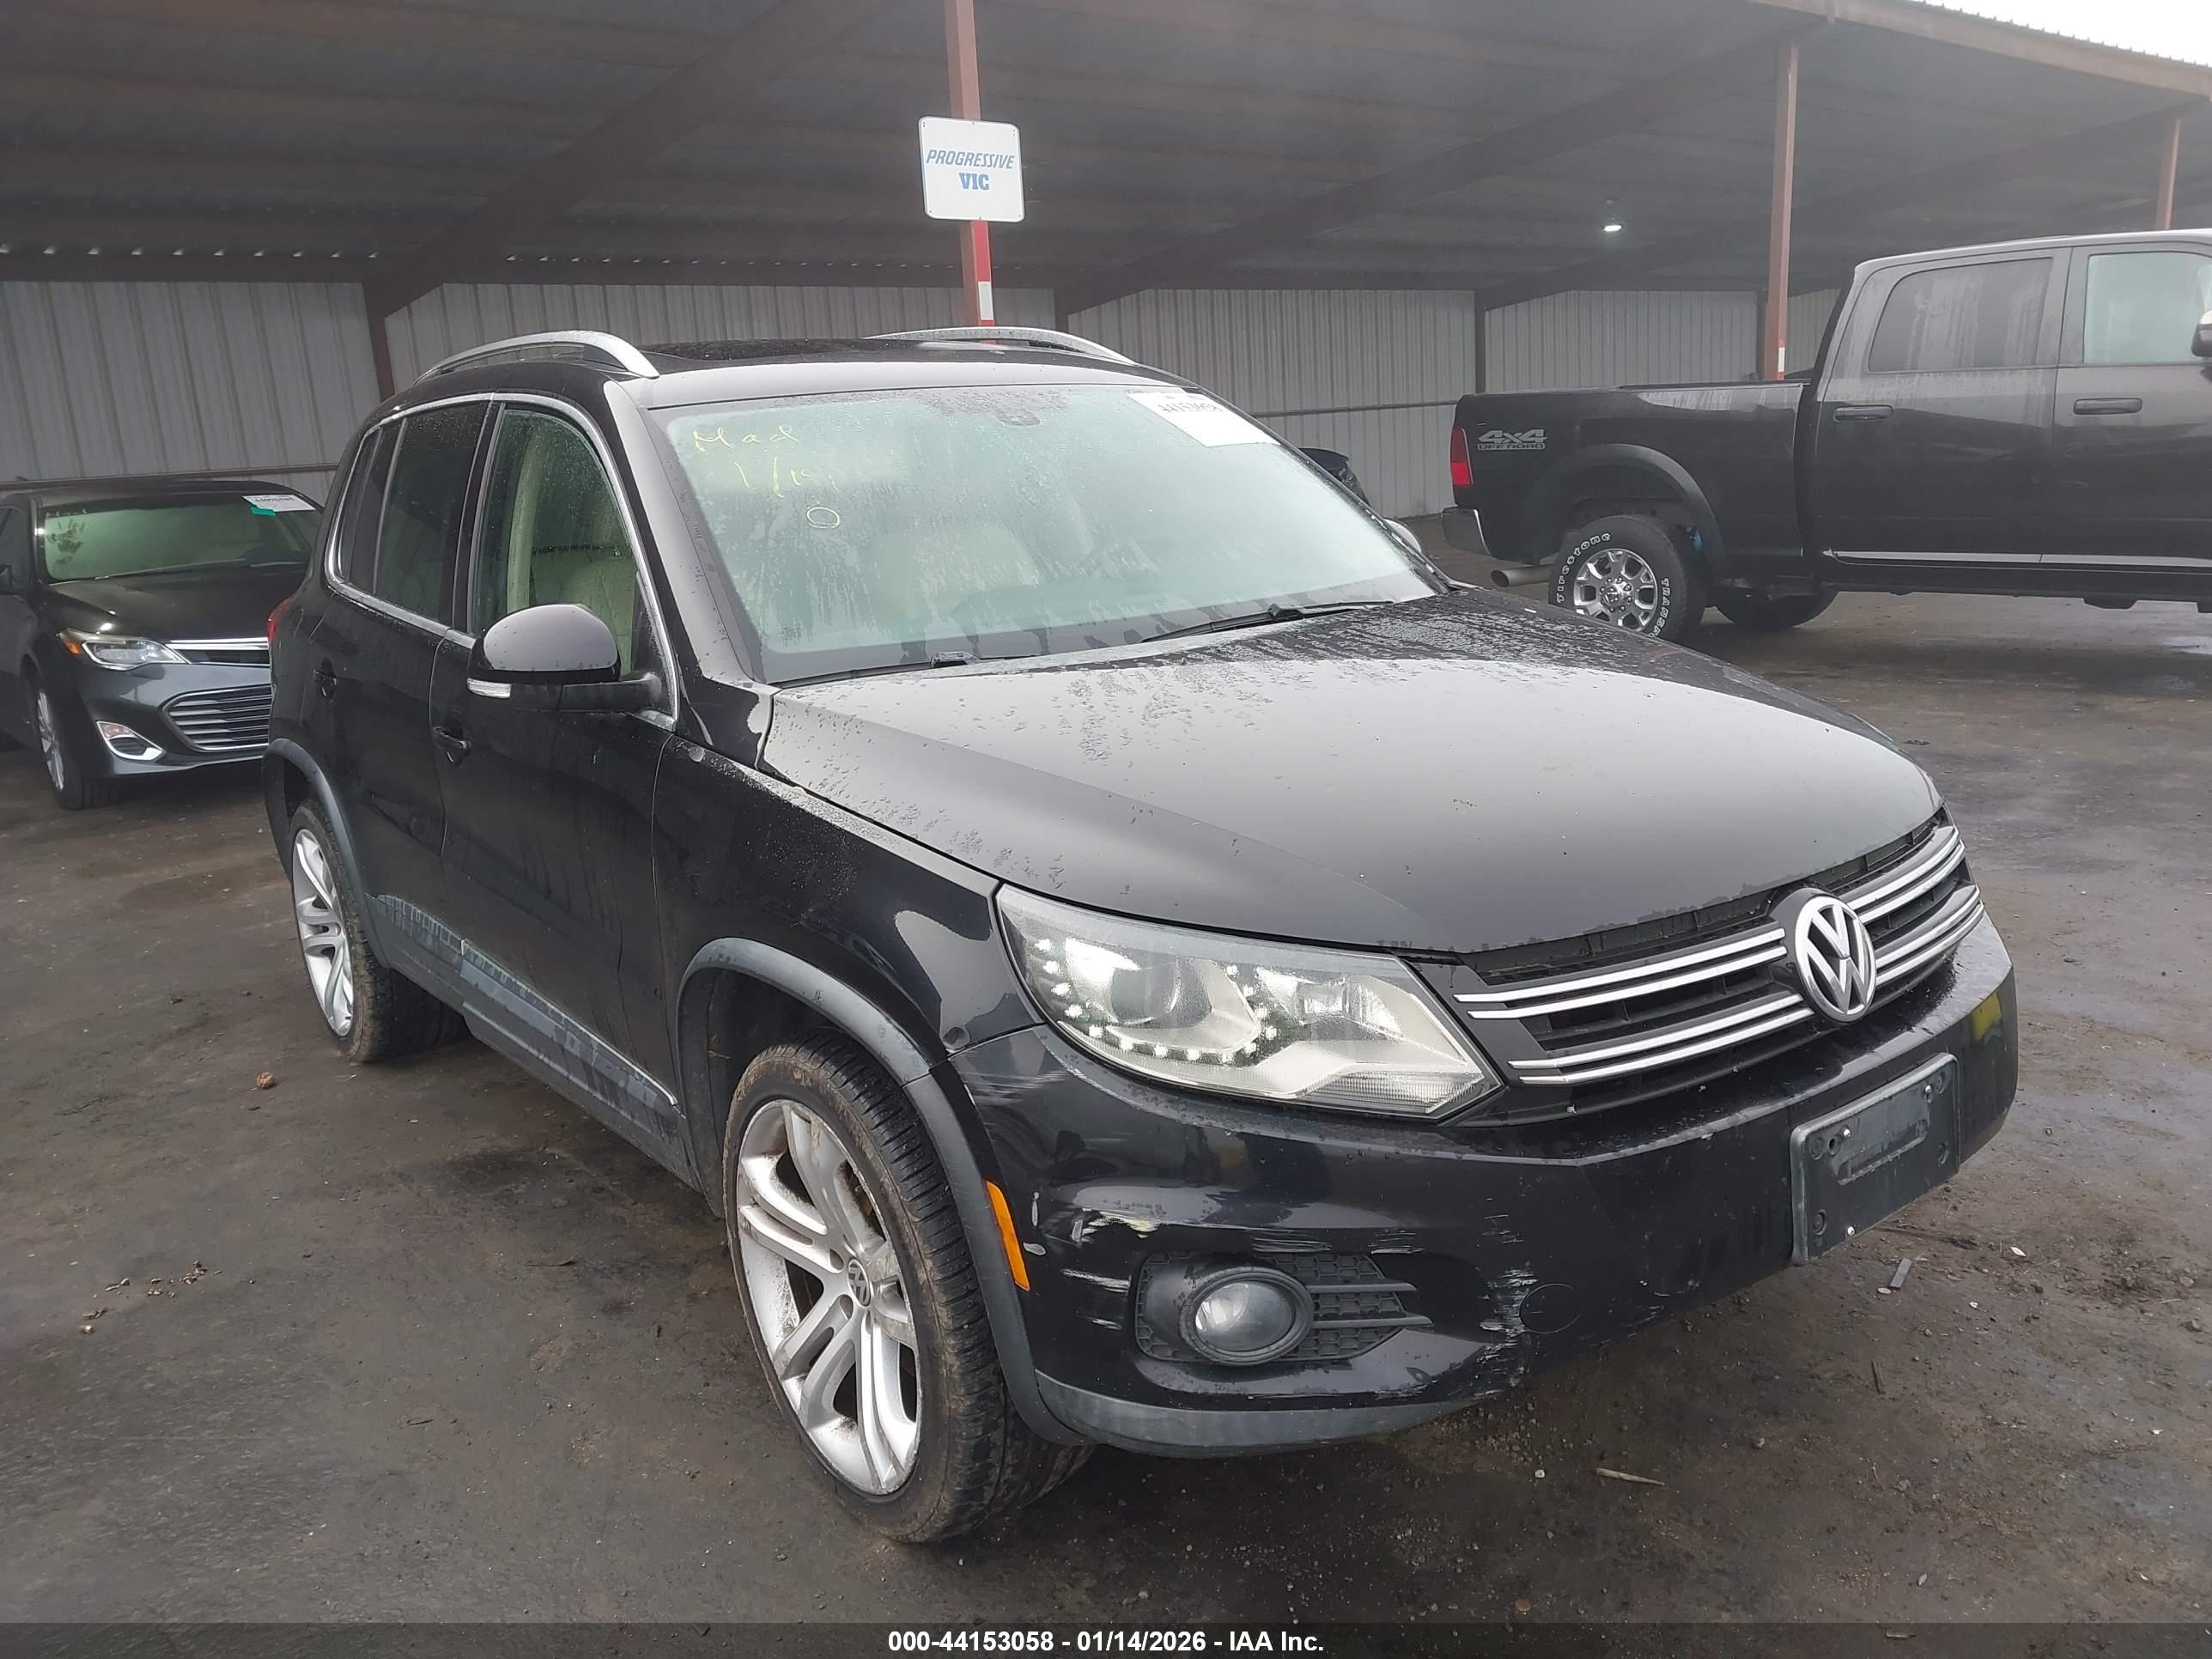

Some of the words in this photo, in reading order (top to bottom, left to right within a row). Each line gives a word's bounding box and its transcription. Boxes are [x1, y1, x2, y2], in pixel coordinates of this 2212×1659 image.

[926, 149, 1015, 169] PROGRESSIVE
[958, 172, 990, 191] VIC
[1798, 898, 1875, 1019] VW
